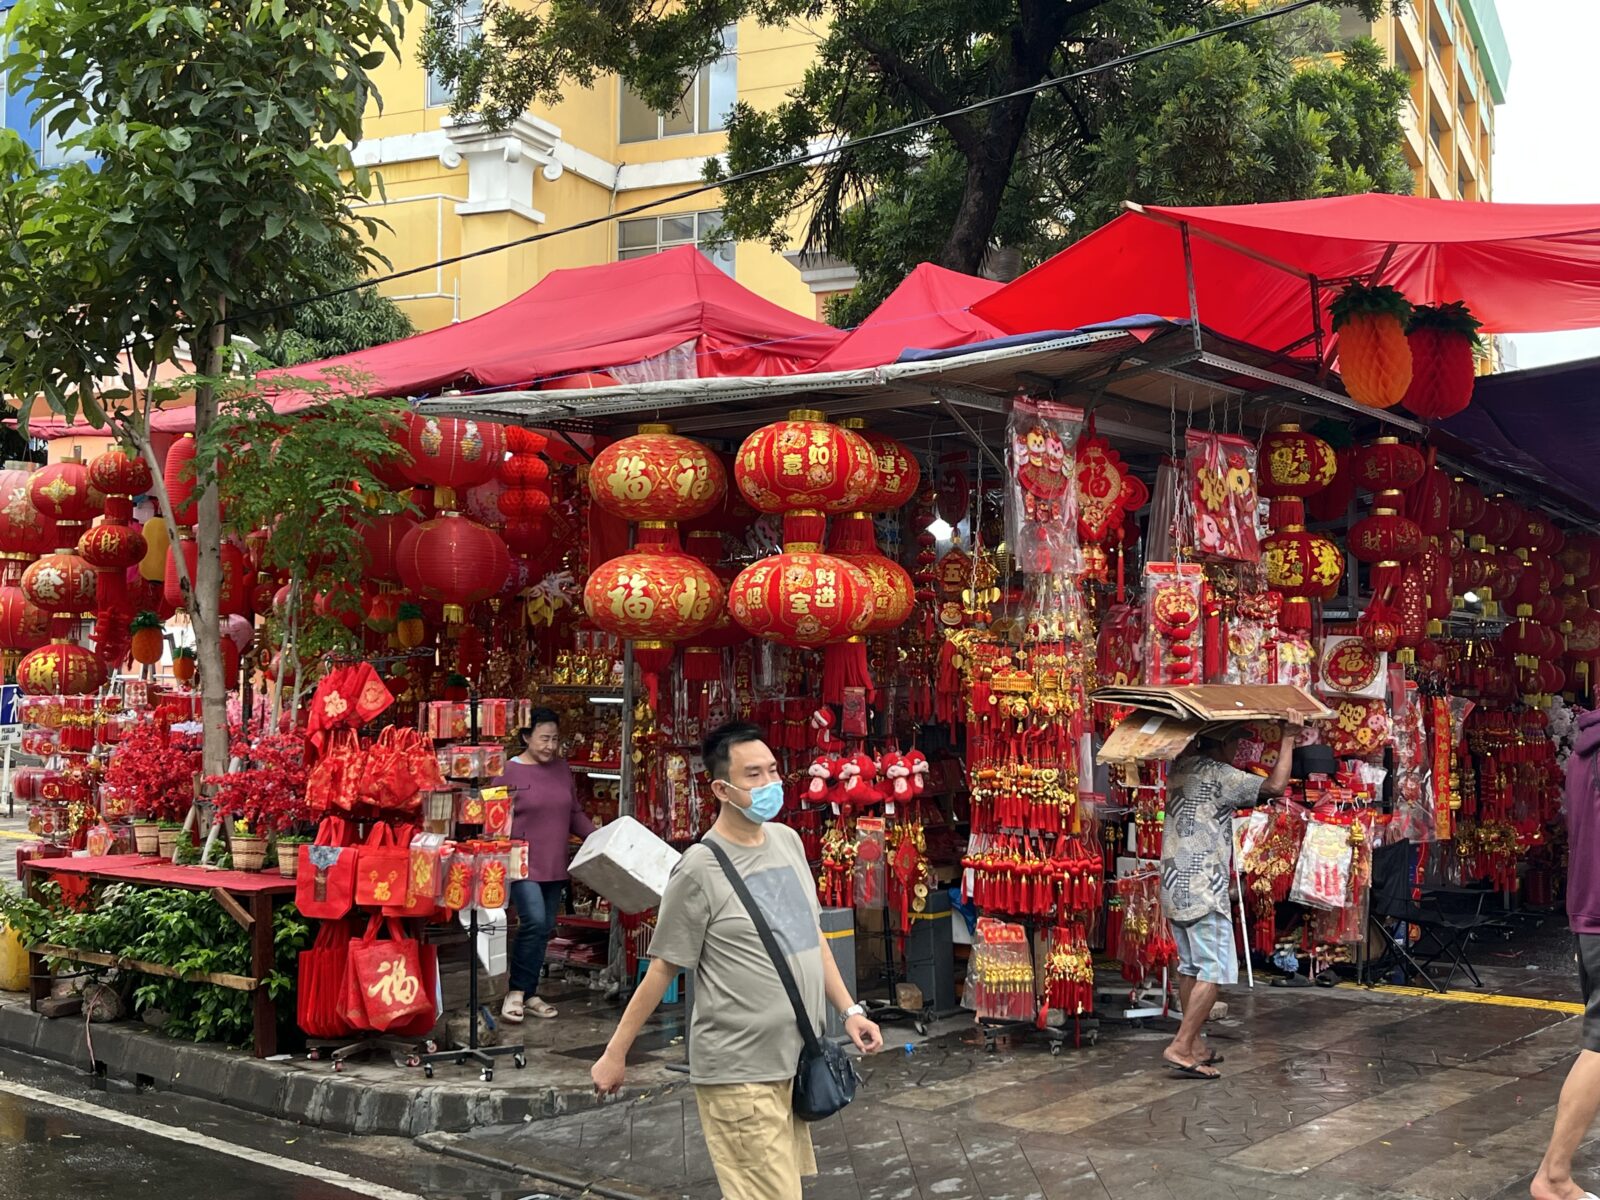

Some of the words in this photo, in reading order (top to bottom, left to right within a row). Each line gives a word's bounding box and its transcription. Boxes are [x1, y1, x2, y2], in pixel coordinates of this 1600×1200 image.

[607, 455, 652, 501] 福
[607, 573, 654, 620] 福
[366, 954, 420, 1006] 福
